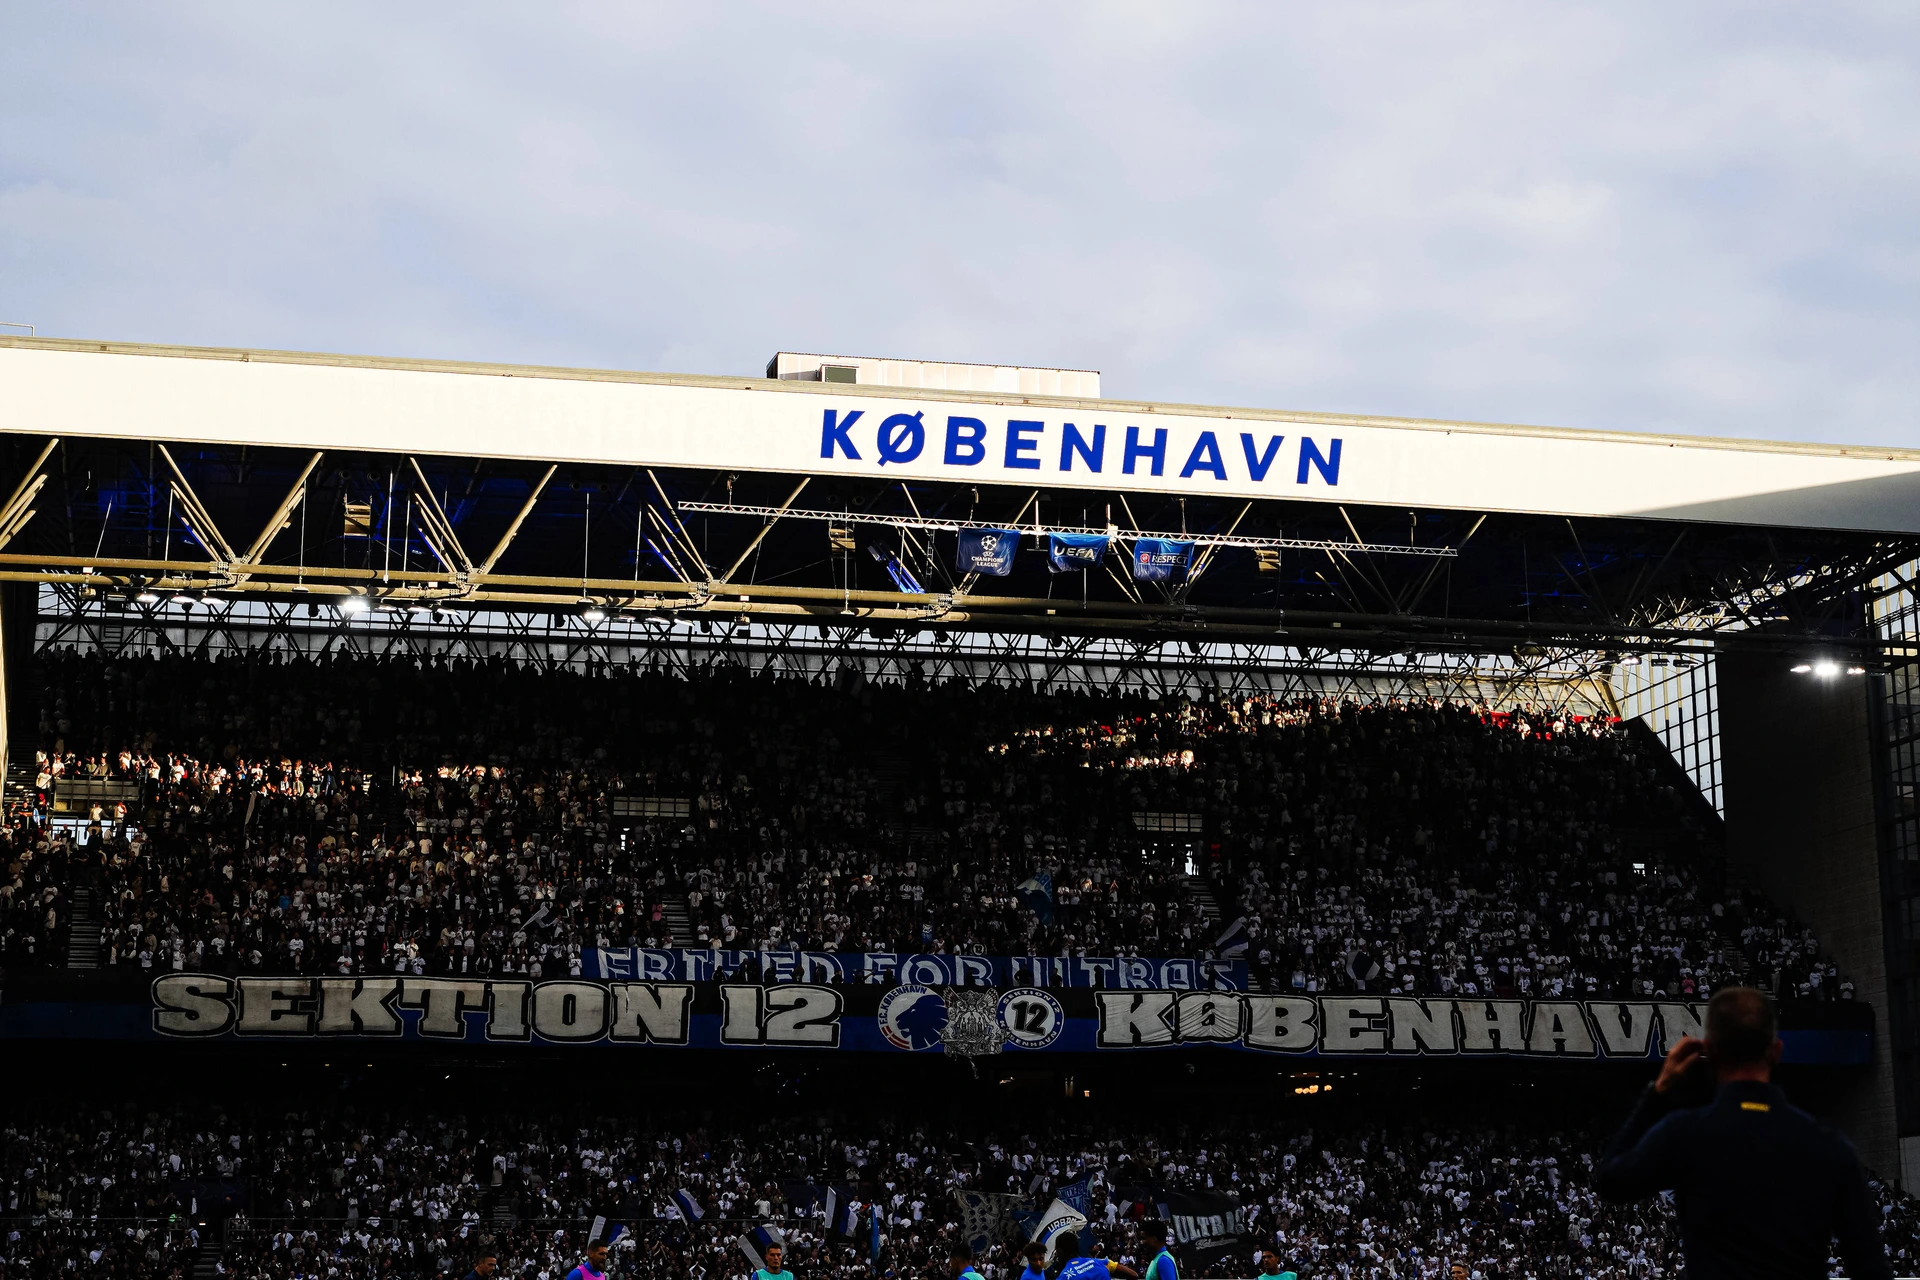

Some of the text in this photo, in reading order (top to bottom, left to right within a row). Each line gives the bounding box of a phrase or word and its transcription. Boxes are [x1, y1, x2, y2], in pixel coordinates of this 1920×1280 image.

[820, 409, 1343, 486] KØBENHAVN
[1054, 546, 1094, 561] UEFA
[1151, 554, 1188, 566] RESPECT
[864, 953, 995, 987] FOR
[152, 974, 846, 1050] SEKTION 12
[1003, 990, 1048, 1005] SEKTION
[1012, 1001, 1050, 1036] 12
